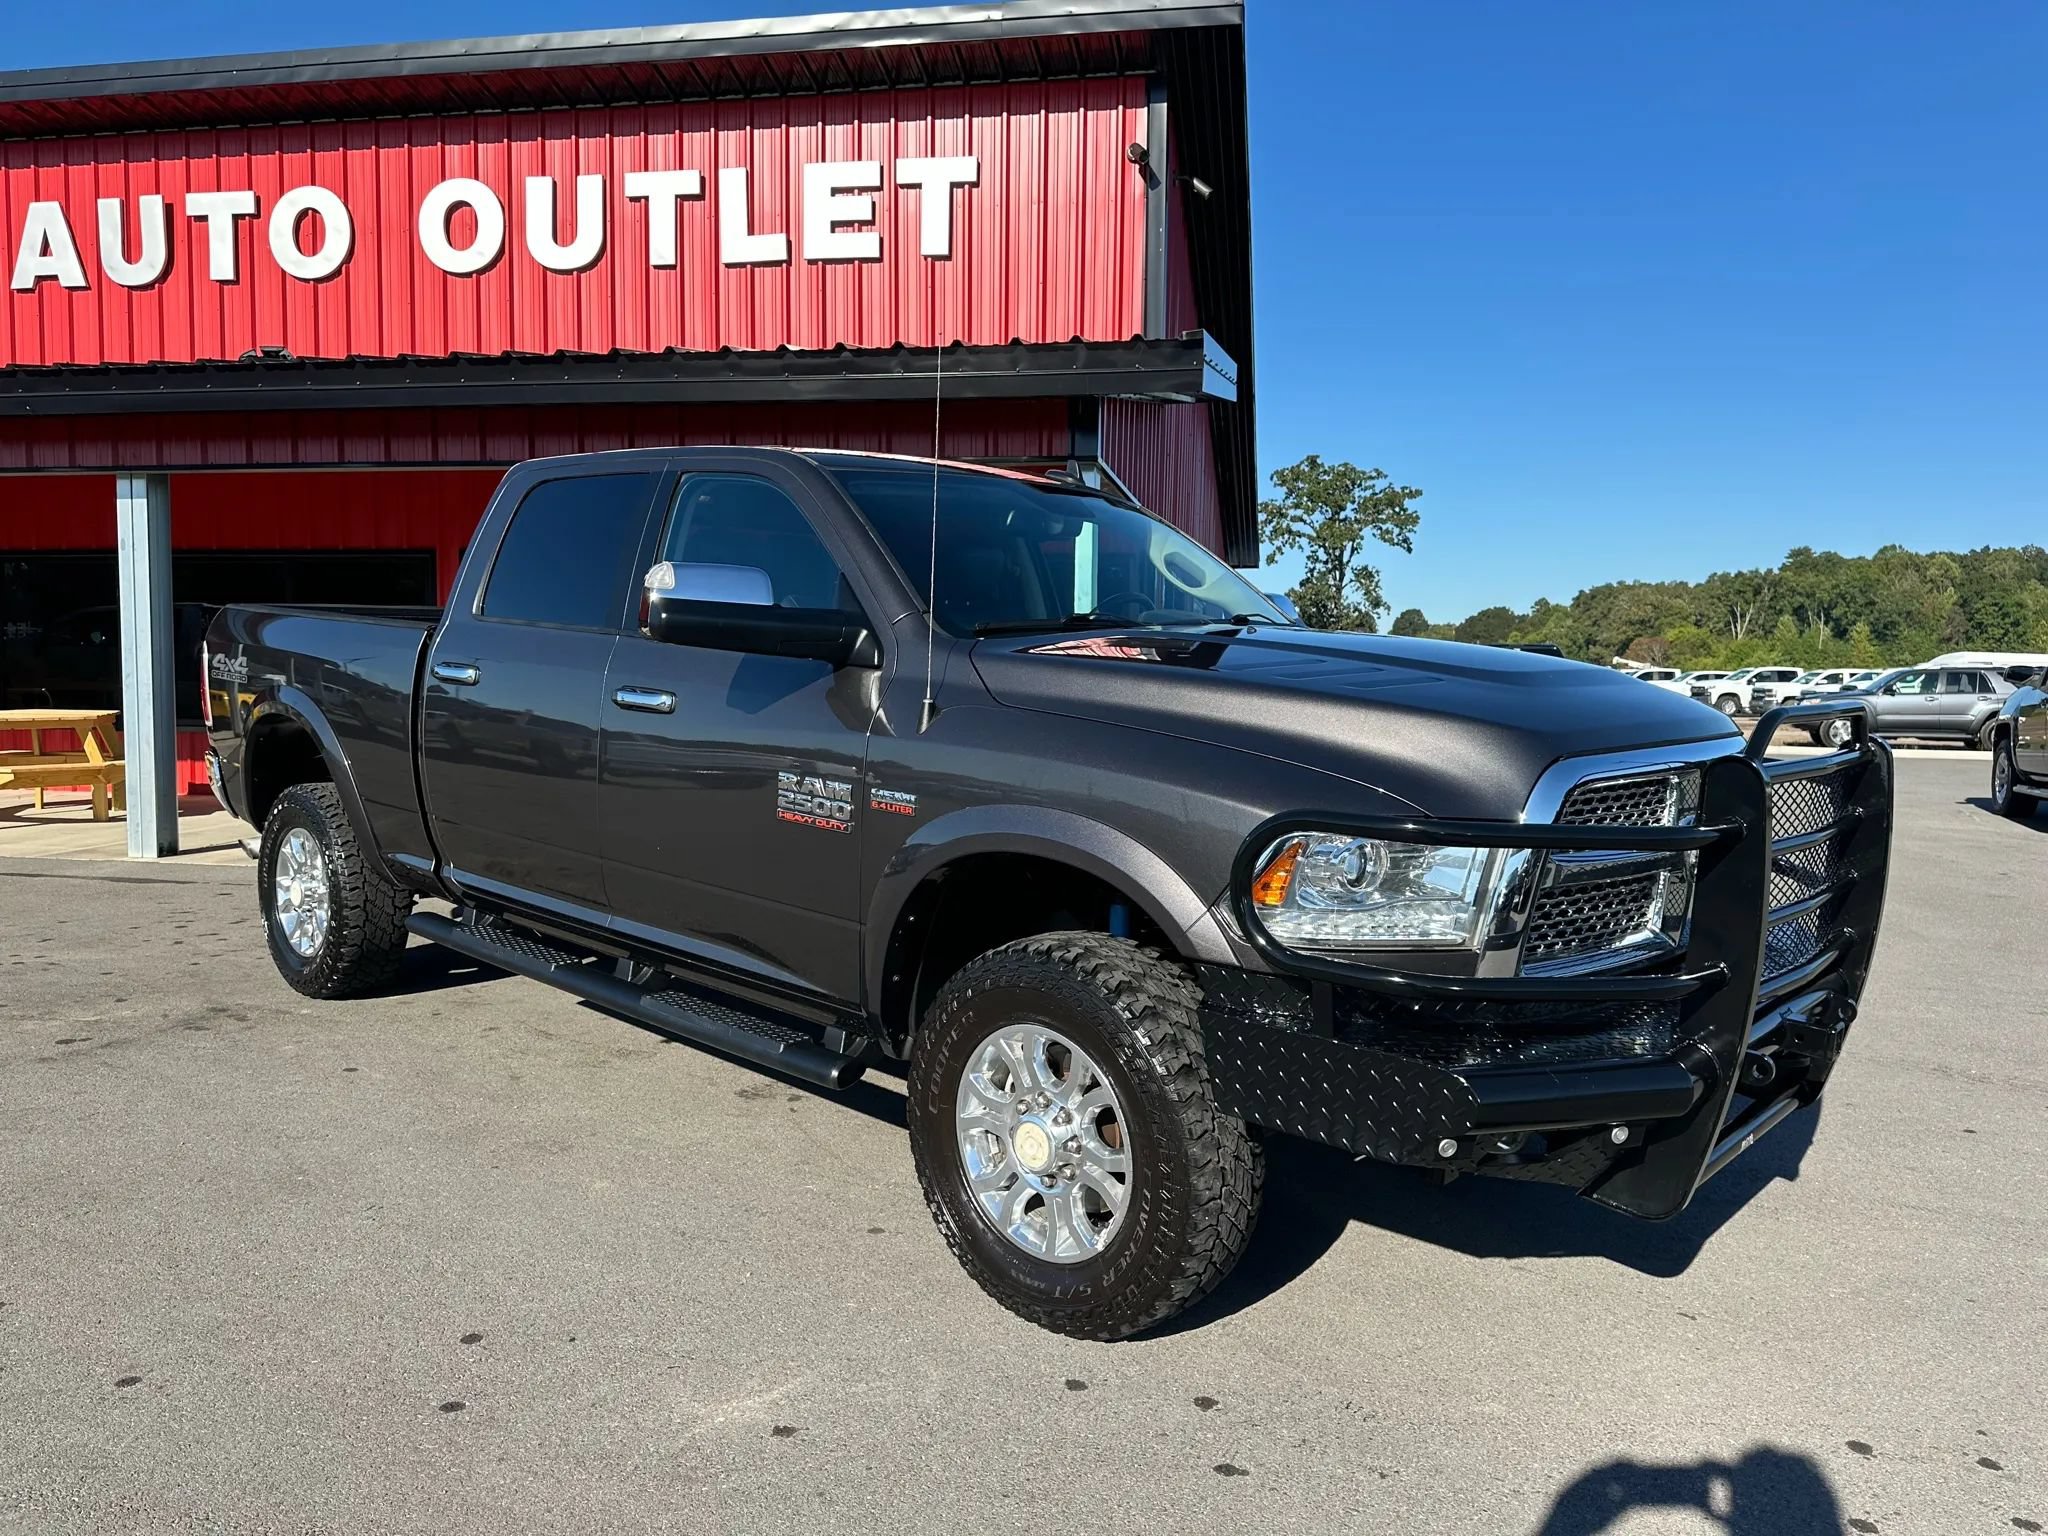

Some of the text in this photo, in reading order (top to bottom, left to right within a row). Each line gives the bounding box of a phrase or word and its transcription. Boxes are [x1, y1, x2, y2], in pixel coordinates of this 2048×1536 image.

[11, 155, 979, 291] AUTO OUTLET
[778, 771, 853, 801] RAM
[778, 789, 853, 820] 2500
[887, 803, 913, 815] LITER
[778, 810, 847, 831] HEAVY DUTY
